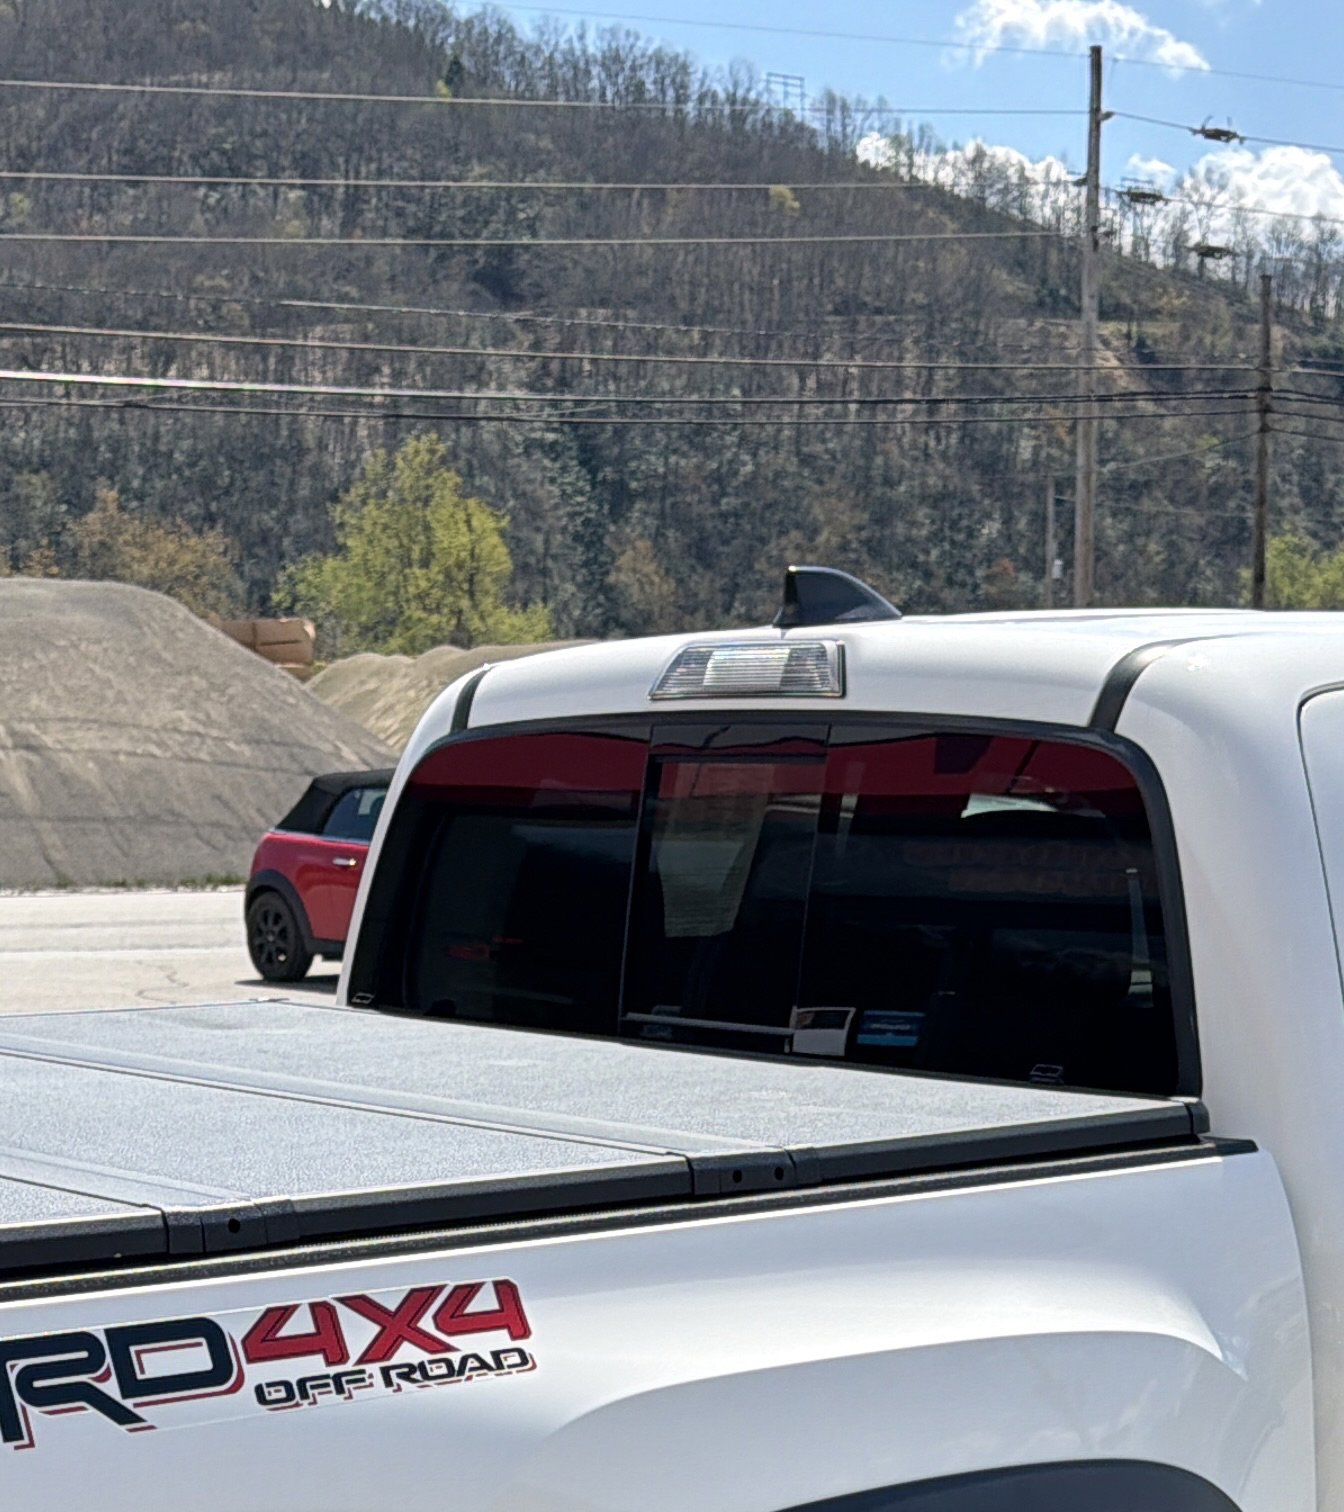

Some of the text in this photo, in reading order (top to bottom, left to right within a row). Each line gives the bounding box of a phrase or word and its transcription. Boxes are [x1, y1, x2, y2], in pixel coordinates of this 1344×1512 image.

[240, 1278, 533, 1368] 4X4
[255, 1346, 538, 1411] OFF ROAD
